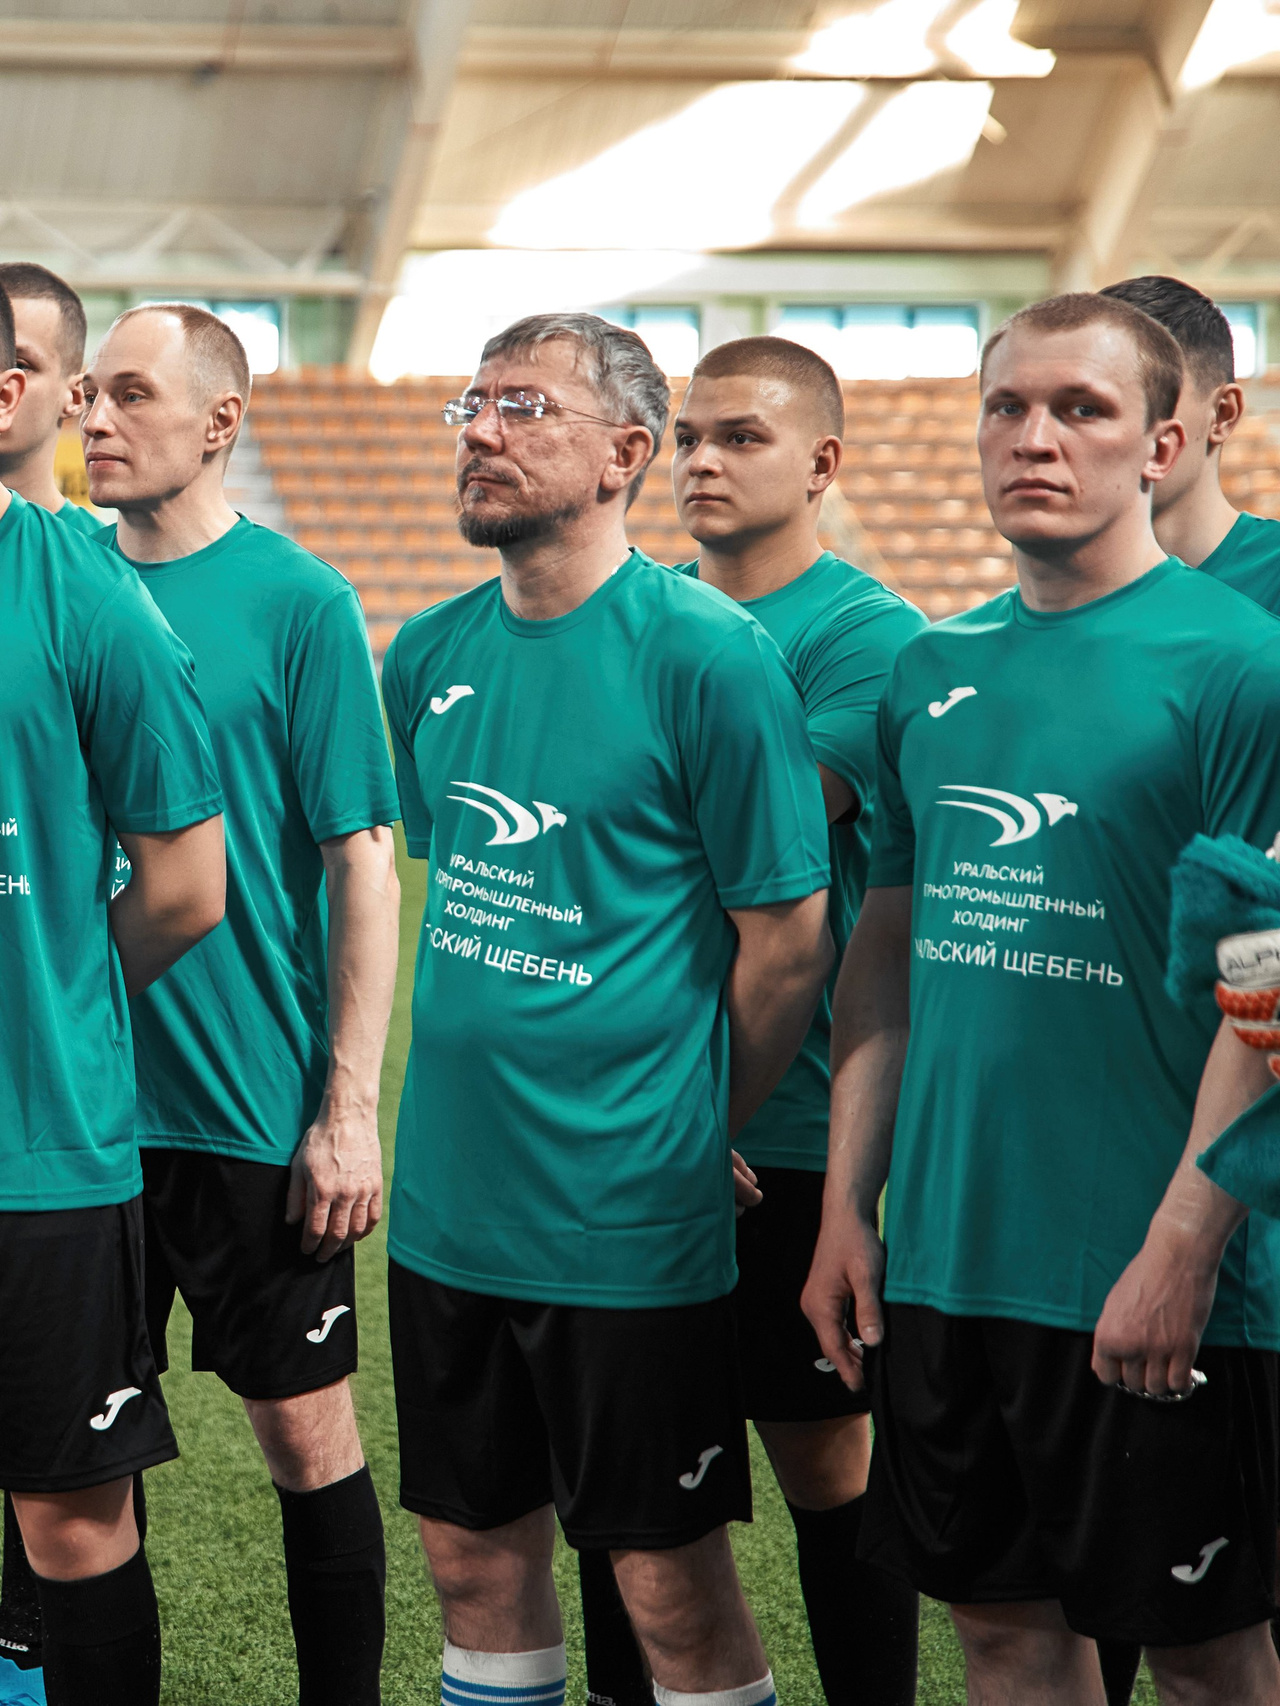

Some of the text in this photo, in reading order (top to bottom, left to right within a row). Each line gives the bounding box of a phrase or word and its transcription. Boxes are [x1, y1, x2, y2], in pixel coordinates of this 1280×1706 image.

[449, 853, 536, 890] УРАЛЬСКИЙ
[953, 860, 1044, 885] УРАЛЬСКИЙ
[443, 899, 515, 931] ХОЛДИНГ
[951, 909, 1030, 933] ХОЛДИНГ
[483, 943, 594, 987] ЩЕБЕНЬ
[1002, 949, 1124, 987] ЩЕБЕНЬ
[1225, 947, 1280, 974] ALP
